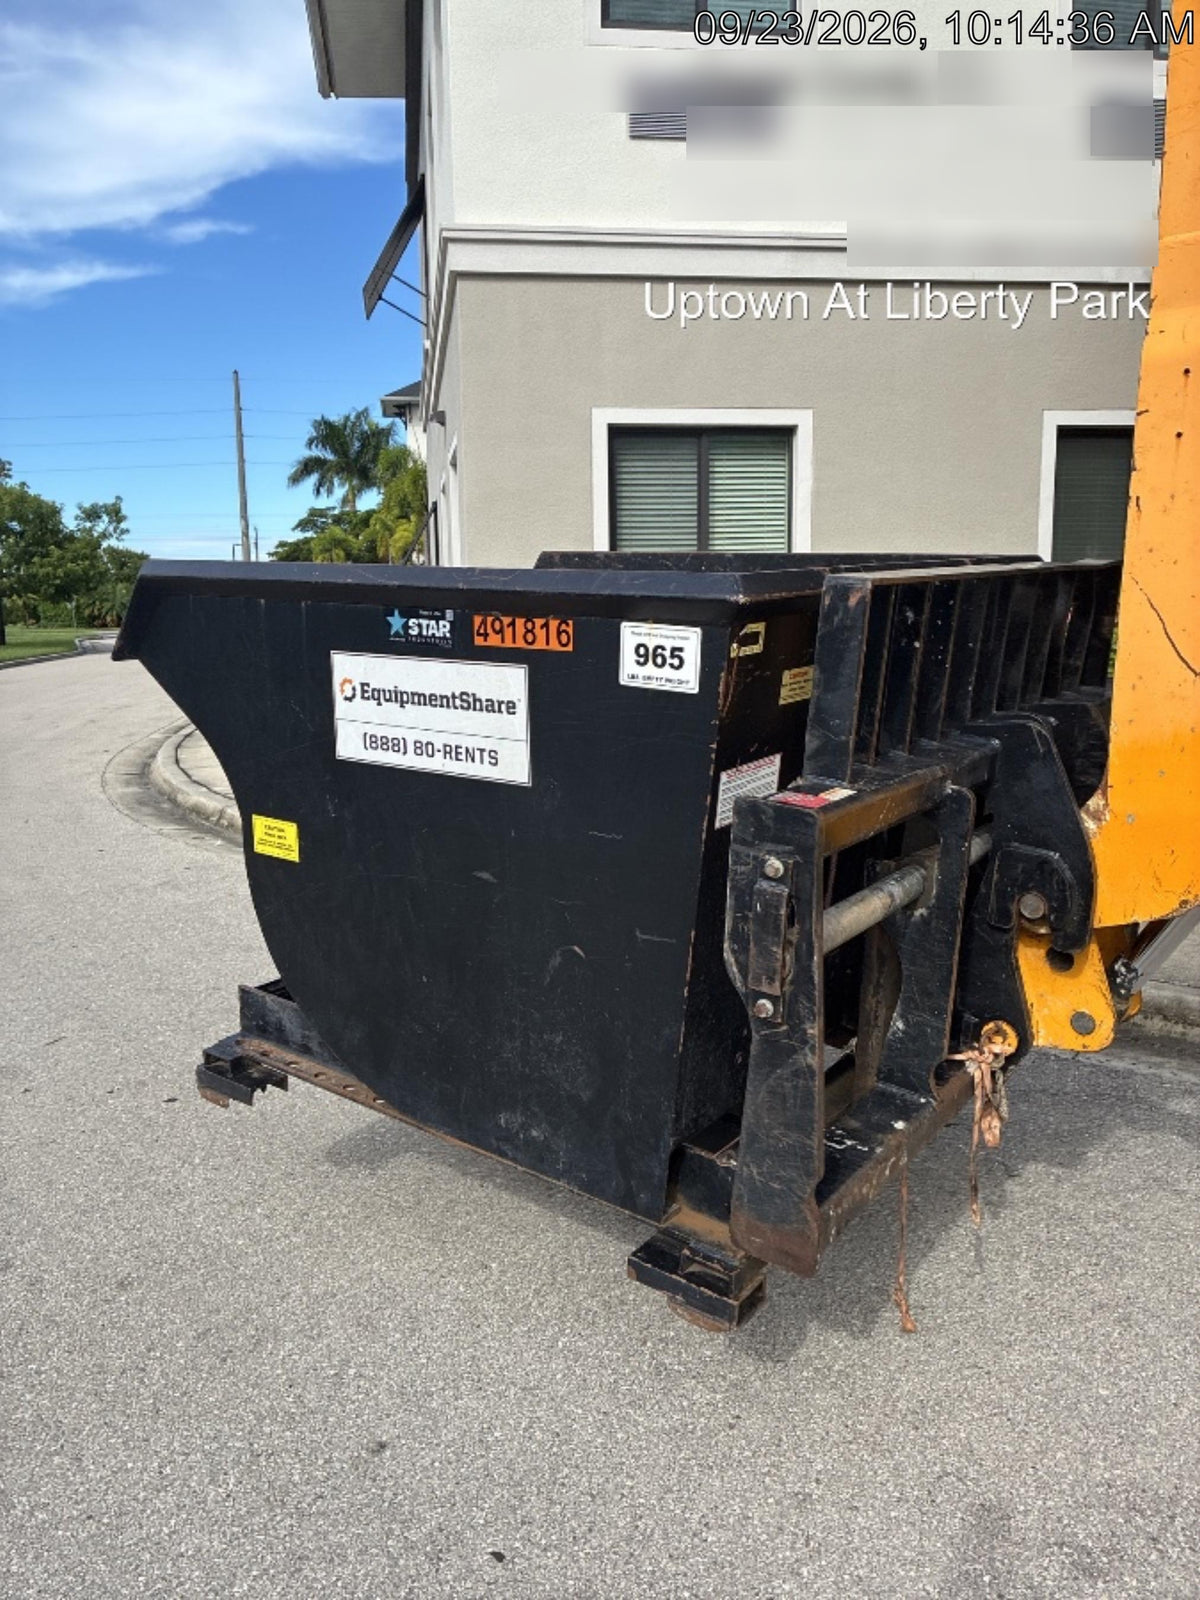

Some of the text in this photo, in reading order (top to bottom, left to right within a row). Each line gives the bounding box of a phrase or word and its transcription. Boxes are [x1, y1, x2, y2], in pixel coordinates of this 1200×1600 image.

[408, 618, 451, 638] STAR
[476, 617, 571, 647] 491816
[634, 643, 685, 671] 965
[359, 682, 517, 715] EquipmentShare
[363, 732, 499, 766] (888) 80-RENTS
